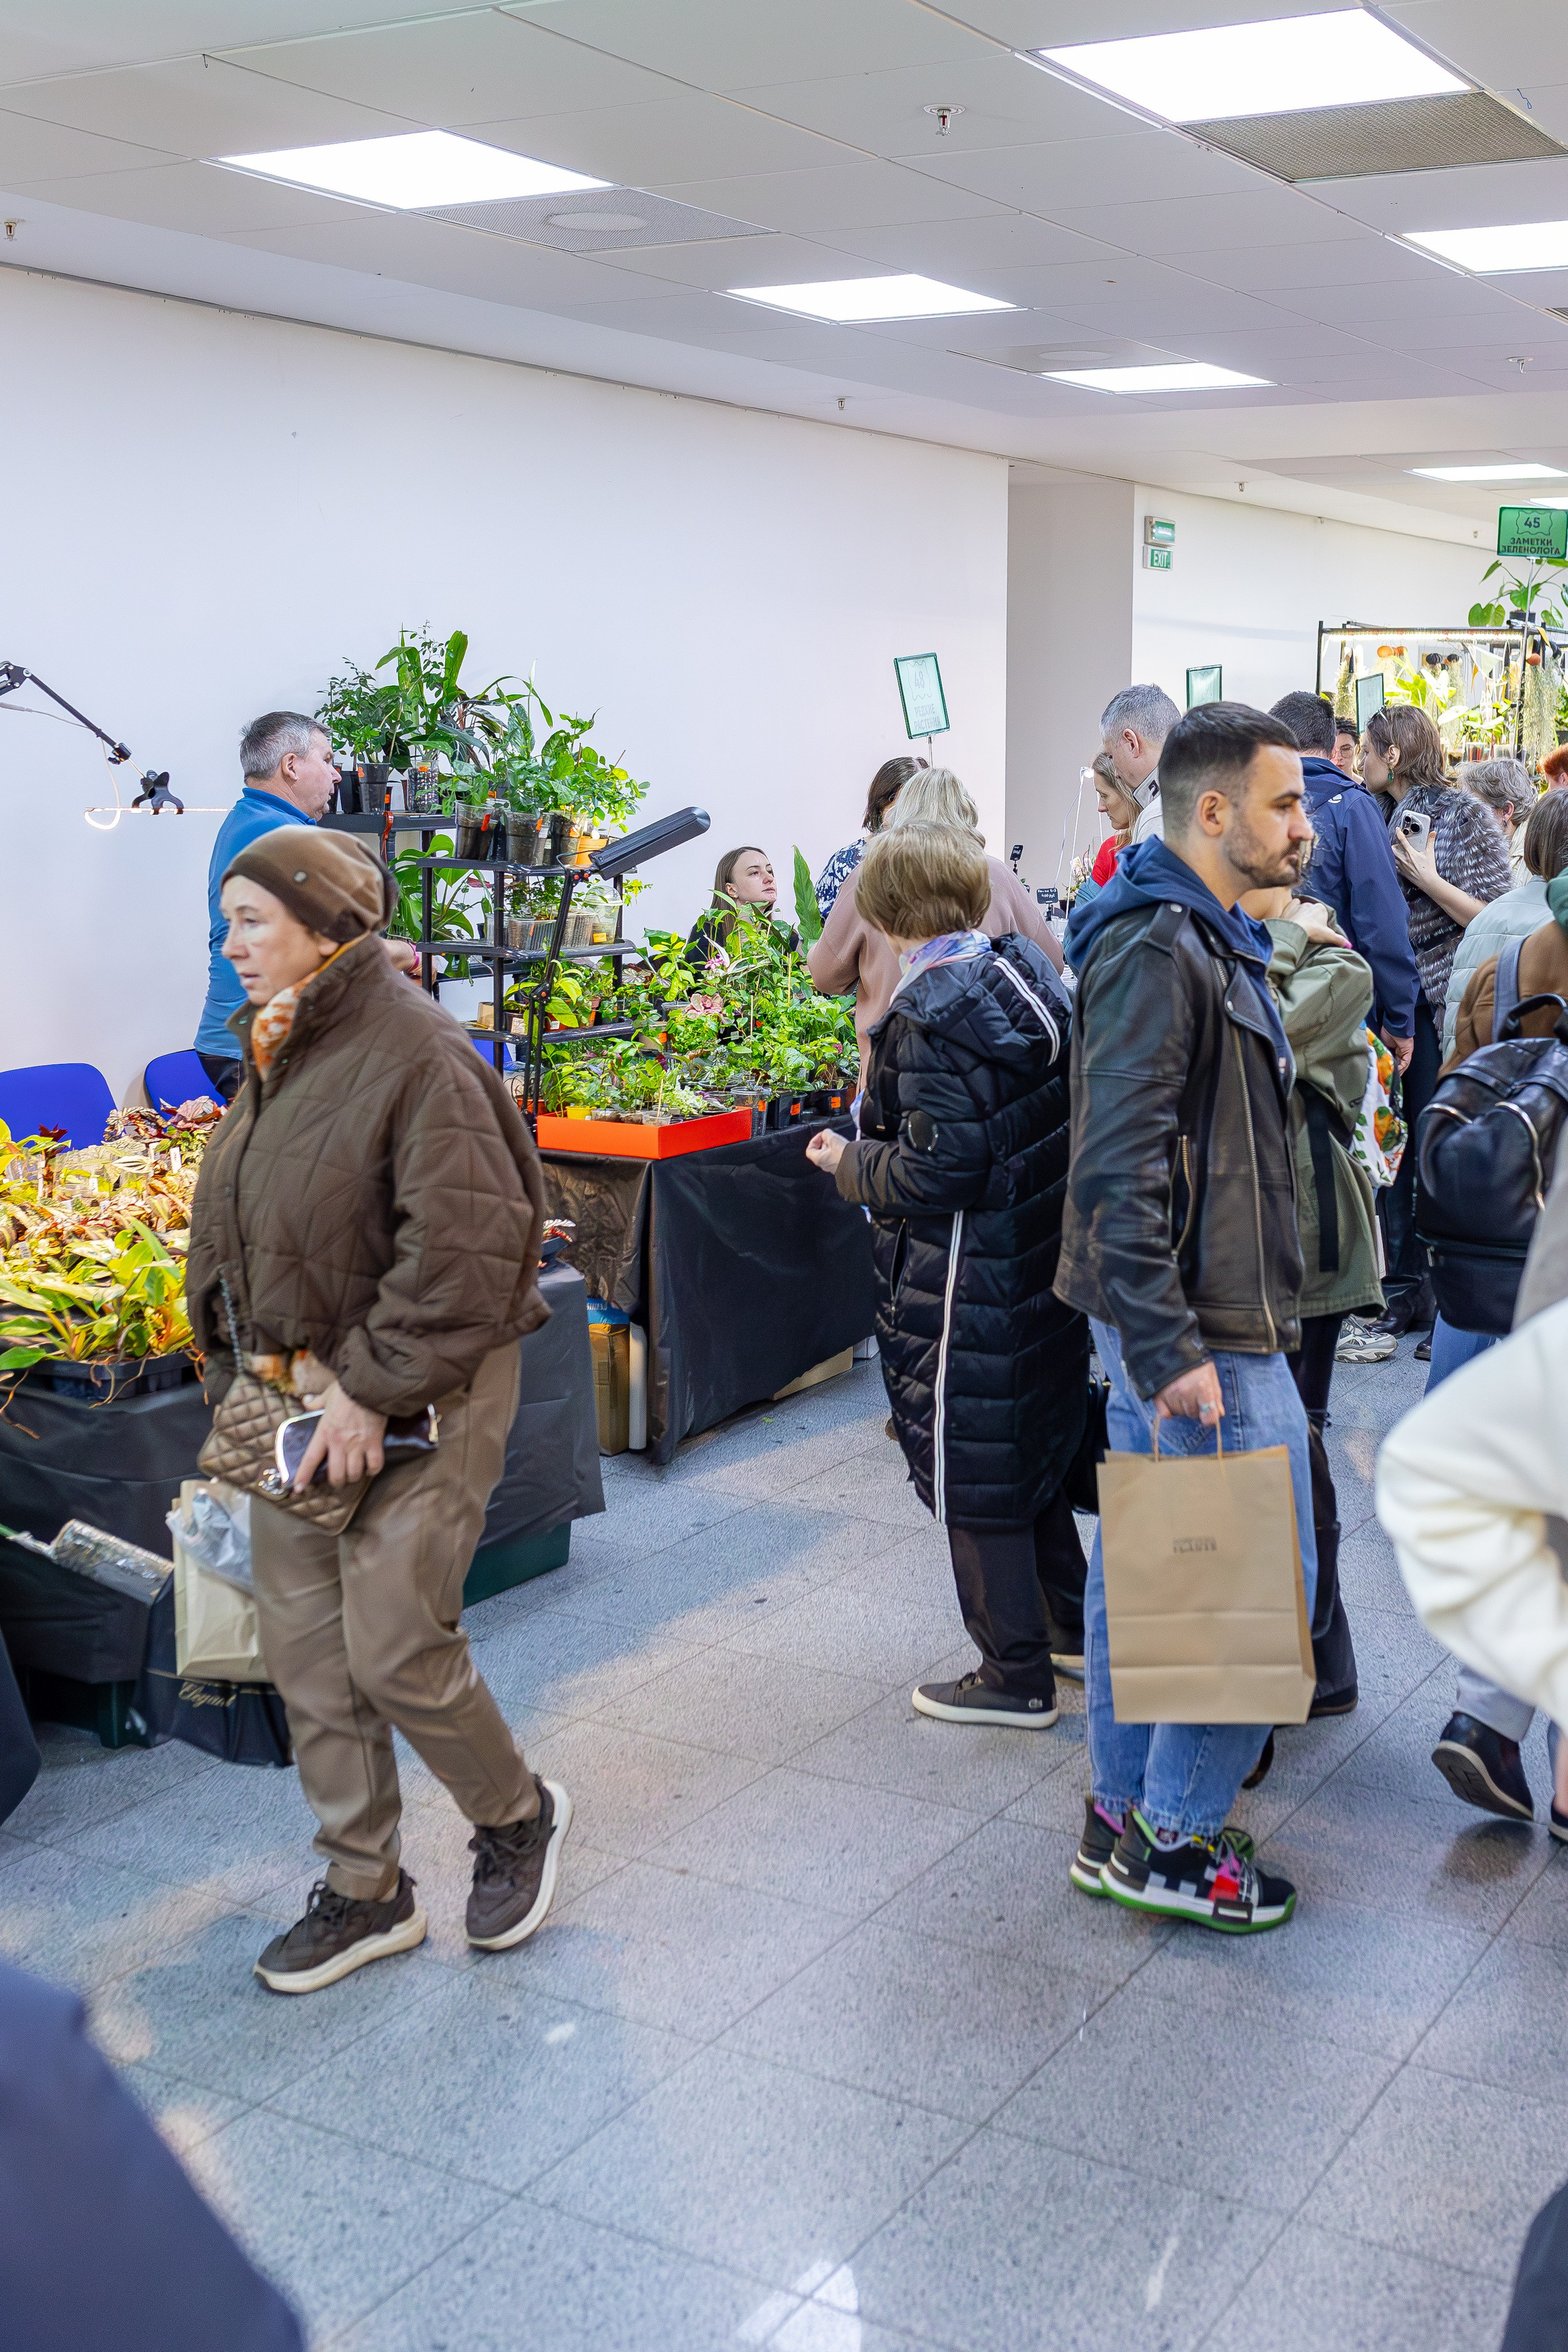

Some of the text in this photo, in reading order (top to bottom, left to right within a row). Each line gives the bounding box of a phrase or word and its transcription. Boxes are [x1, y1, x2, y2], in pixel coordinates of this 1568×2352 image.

[1524, 516, 1540, 528] 45
[1510, 537, 1553, 546] ЗАМЕТКИ
[1502, 545, 1561, 555] ЗЕЛЕНОЛОГА
[1153, 550, 1168, 567] EXIT
[914, 703, 935, 717] РЕДКИЕ
[914, 715, 941, 731] РАСТЕНИЯ
